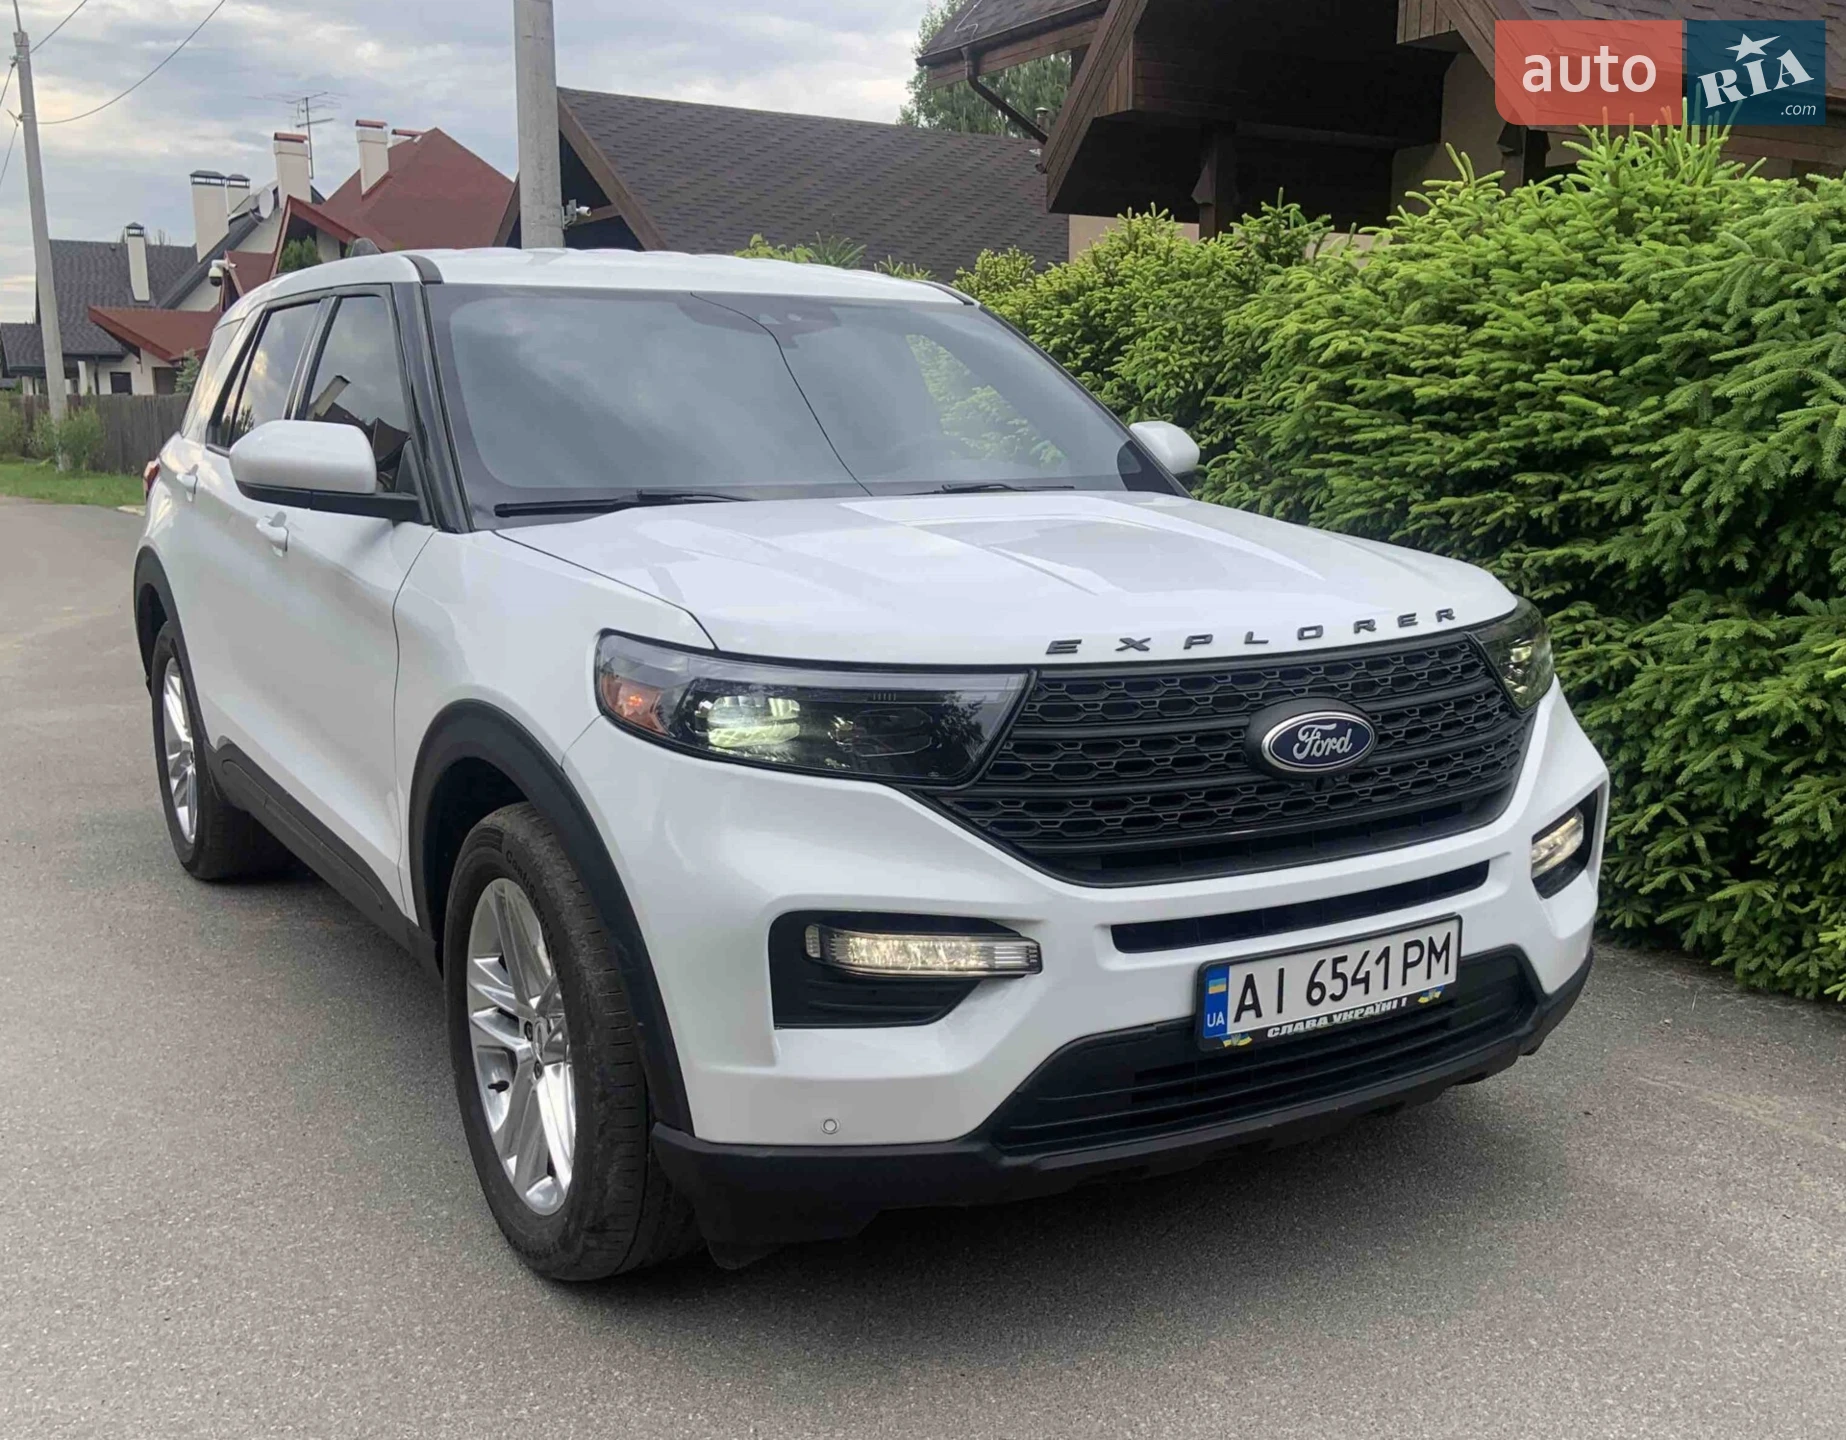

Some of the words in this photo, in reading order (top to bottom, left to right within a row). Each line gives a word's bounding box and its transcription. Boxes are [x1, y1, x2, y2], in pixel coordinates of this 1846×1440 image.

[1045, 607, 1457, 655] EXPLORER
[1292, 723, 1353, 760] Ford
[1233, 966, 1286, 1023] AI
[1306, 945, 1391, 1007] 6541
[1401, 931, 1452, 986] PM
[1207, 1012, 1226, 1028] UA
[1267, 1016, 1329, 1038] СЛАВА
